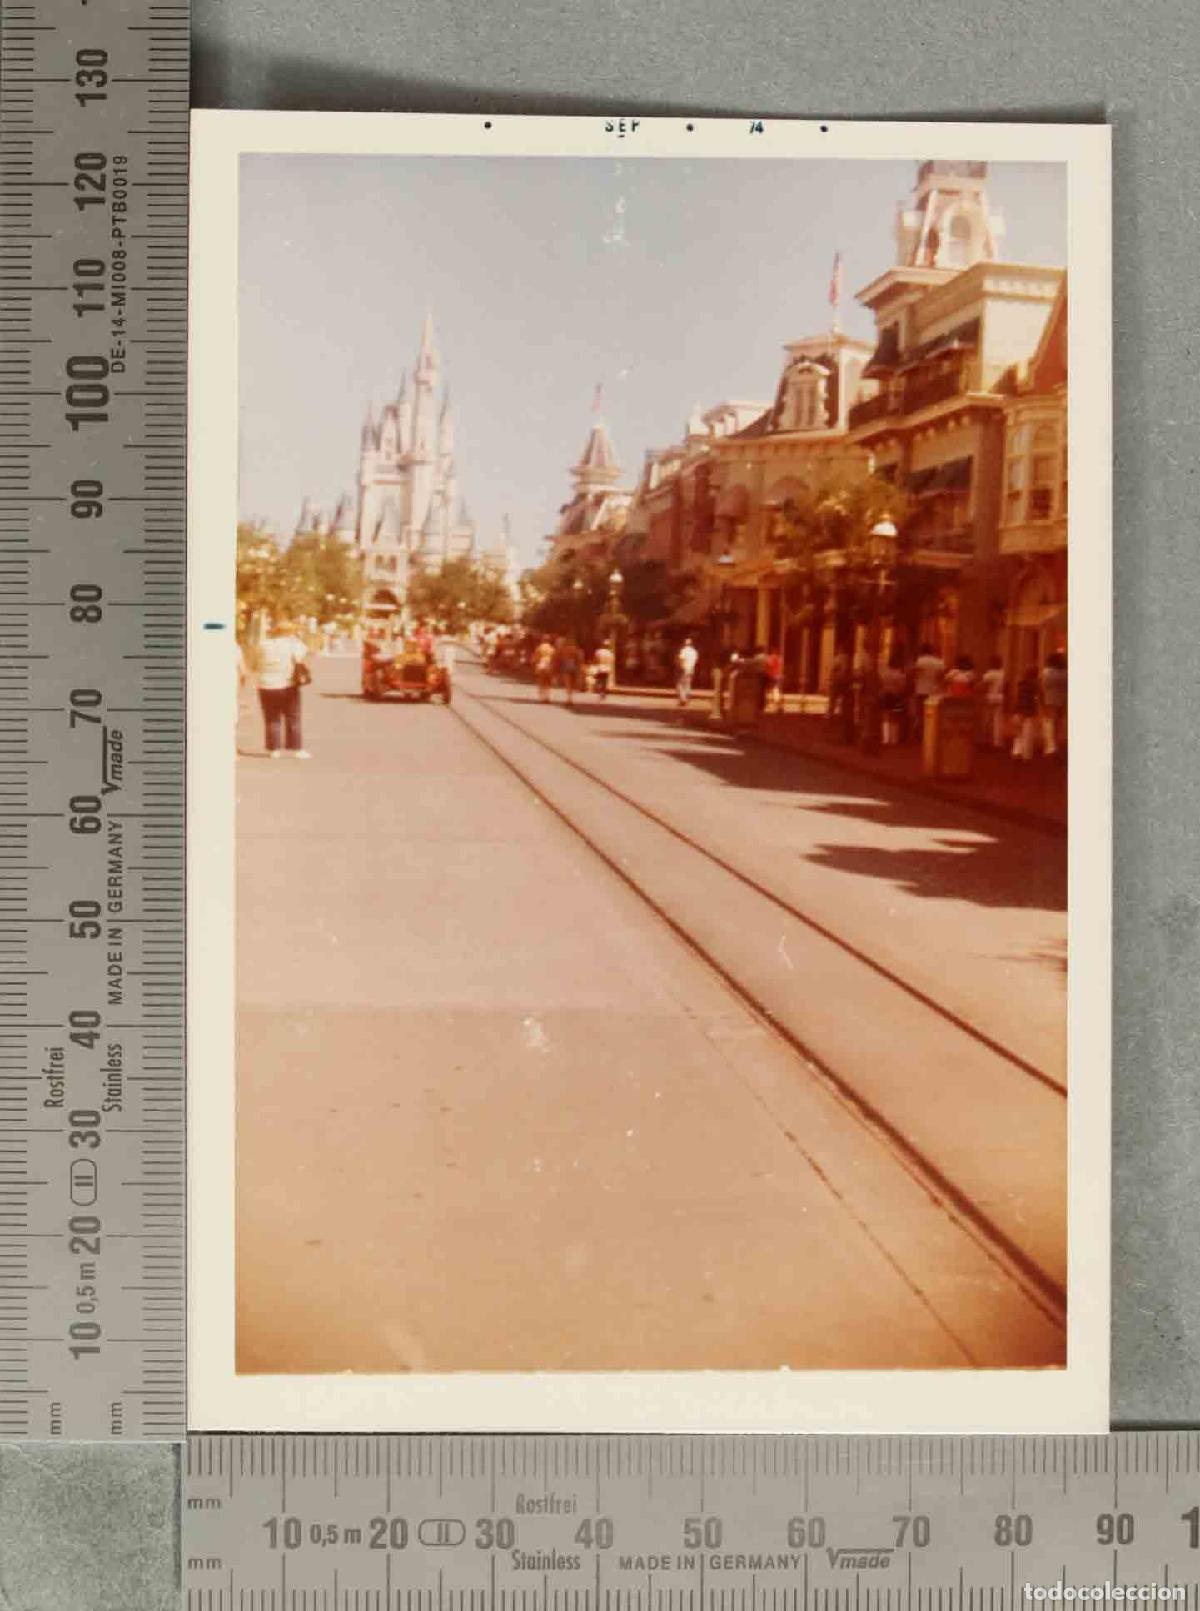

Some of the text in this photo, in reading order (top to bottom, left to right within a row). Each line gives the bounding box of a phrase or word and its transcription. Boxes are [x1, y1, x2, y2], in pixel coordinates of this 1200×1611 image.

[74, 48, 108, 108] 130
[73, 152, 107, 212] 120
[72, 259, 106, 318] 110
[64, 355, 110, 432] 100
[70, 479, 104, 519] 90
[69, 584, 103, 624] 80
[69, 688, 103, 729] 70
[69, 795, 102, 834] 60
[69, 900, 102, 940] 50
[107, 820, 123, 1005] MADE IN GERMANY
[69, 1010, 102, 1049] 40
[43, 1046, 65, 1108] Rostfrei
[102, 1043, 123, 1112] Stainless
[69, 1109, 102, 1149] 30
[69, 1216, 102, 1255] 20
[69, 1321, 102, 1360] 10
[51, 1402, 63, 1435] mm
[111, 1402, 123, 1435] mm
[187, 1497, 222, 1510] mm
[515, 1494, 577, 1515] Rostfrei
[263, 1518, 301, 1550] 10
[369, 1518, 408, 1550] 20
[474, 1518, 515, 1550] 30
[574, 1518, 614, 1549] 40
[683, 1517, 723, 1549] 50
[787, 1516, 826, 1549] 60
[893, 1515, 930, 1548] 70
[994, 1514, 1033, 1547] 80
[1096, 1513, 1135, 1546] 90
[188, 1557, 222, 1570] mm
[511, 1550, 581, 1571] Stainless
[619, 1554, 801, 1570] MADE IN GERMANY
